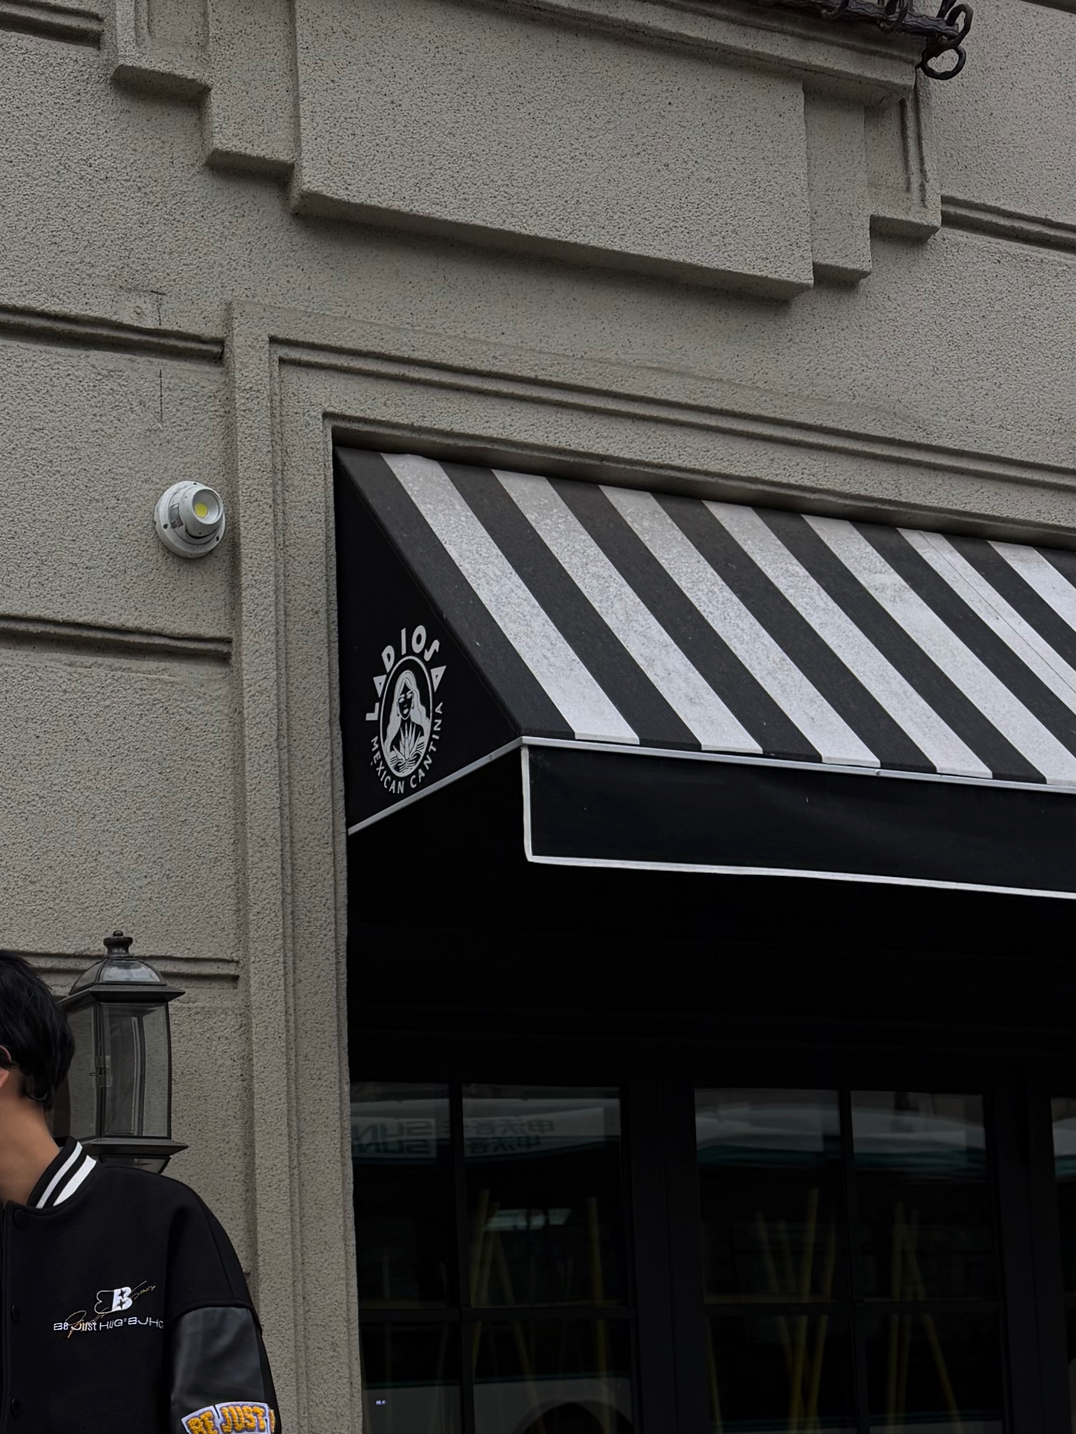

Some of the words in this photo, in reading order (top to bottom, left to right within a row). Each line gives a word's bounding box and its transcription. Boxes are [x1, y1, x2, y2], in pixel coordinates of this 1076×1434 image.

[370, 736, 405, 794] MEXICAN
[409, 702, 444, 789] CANTINA
[220, 1405, 266, 1434] JUST
